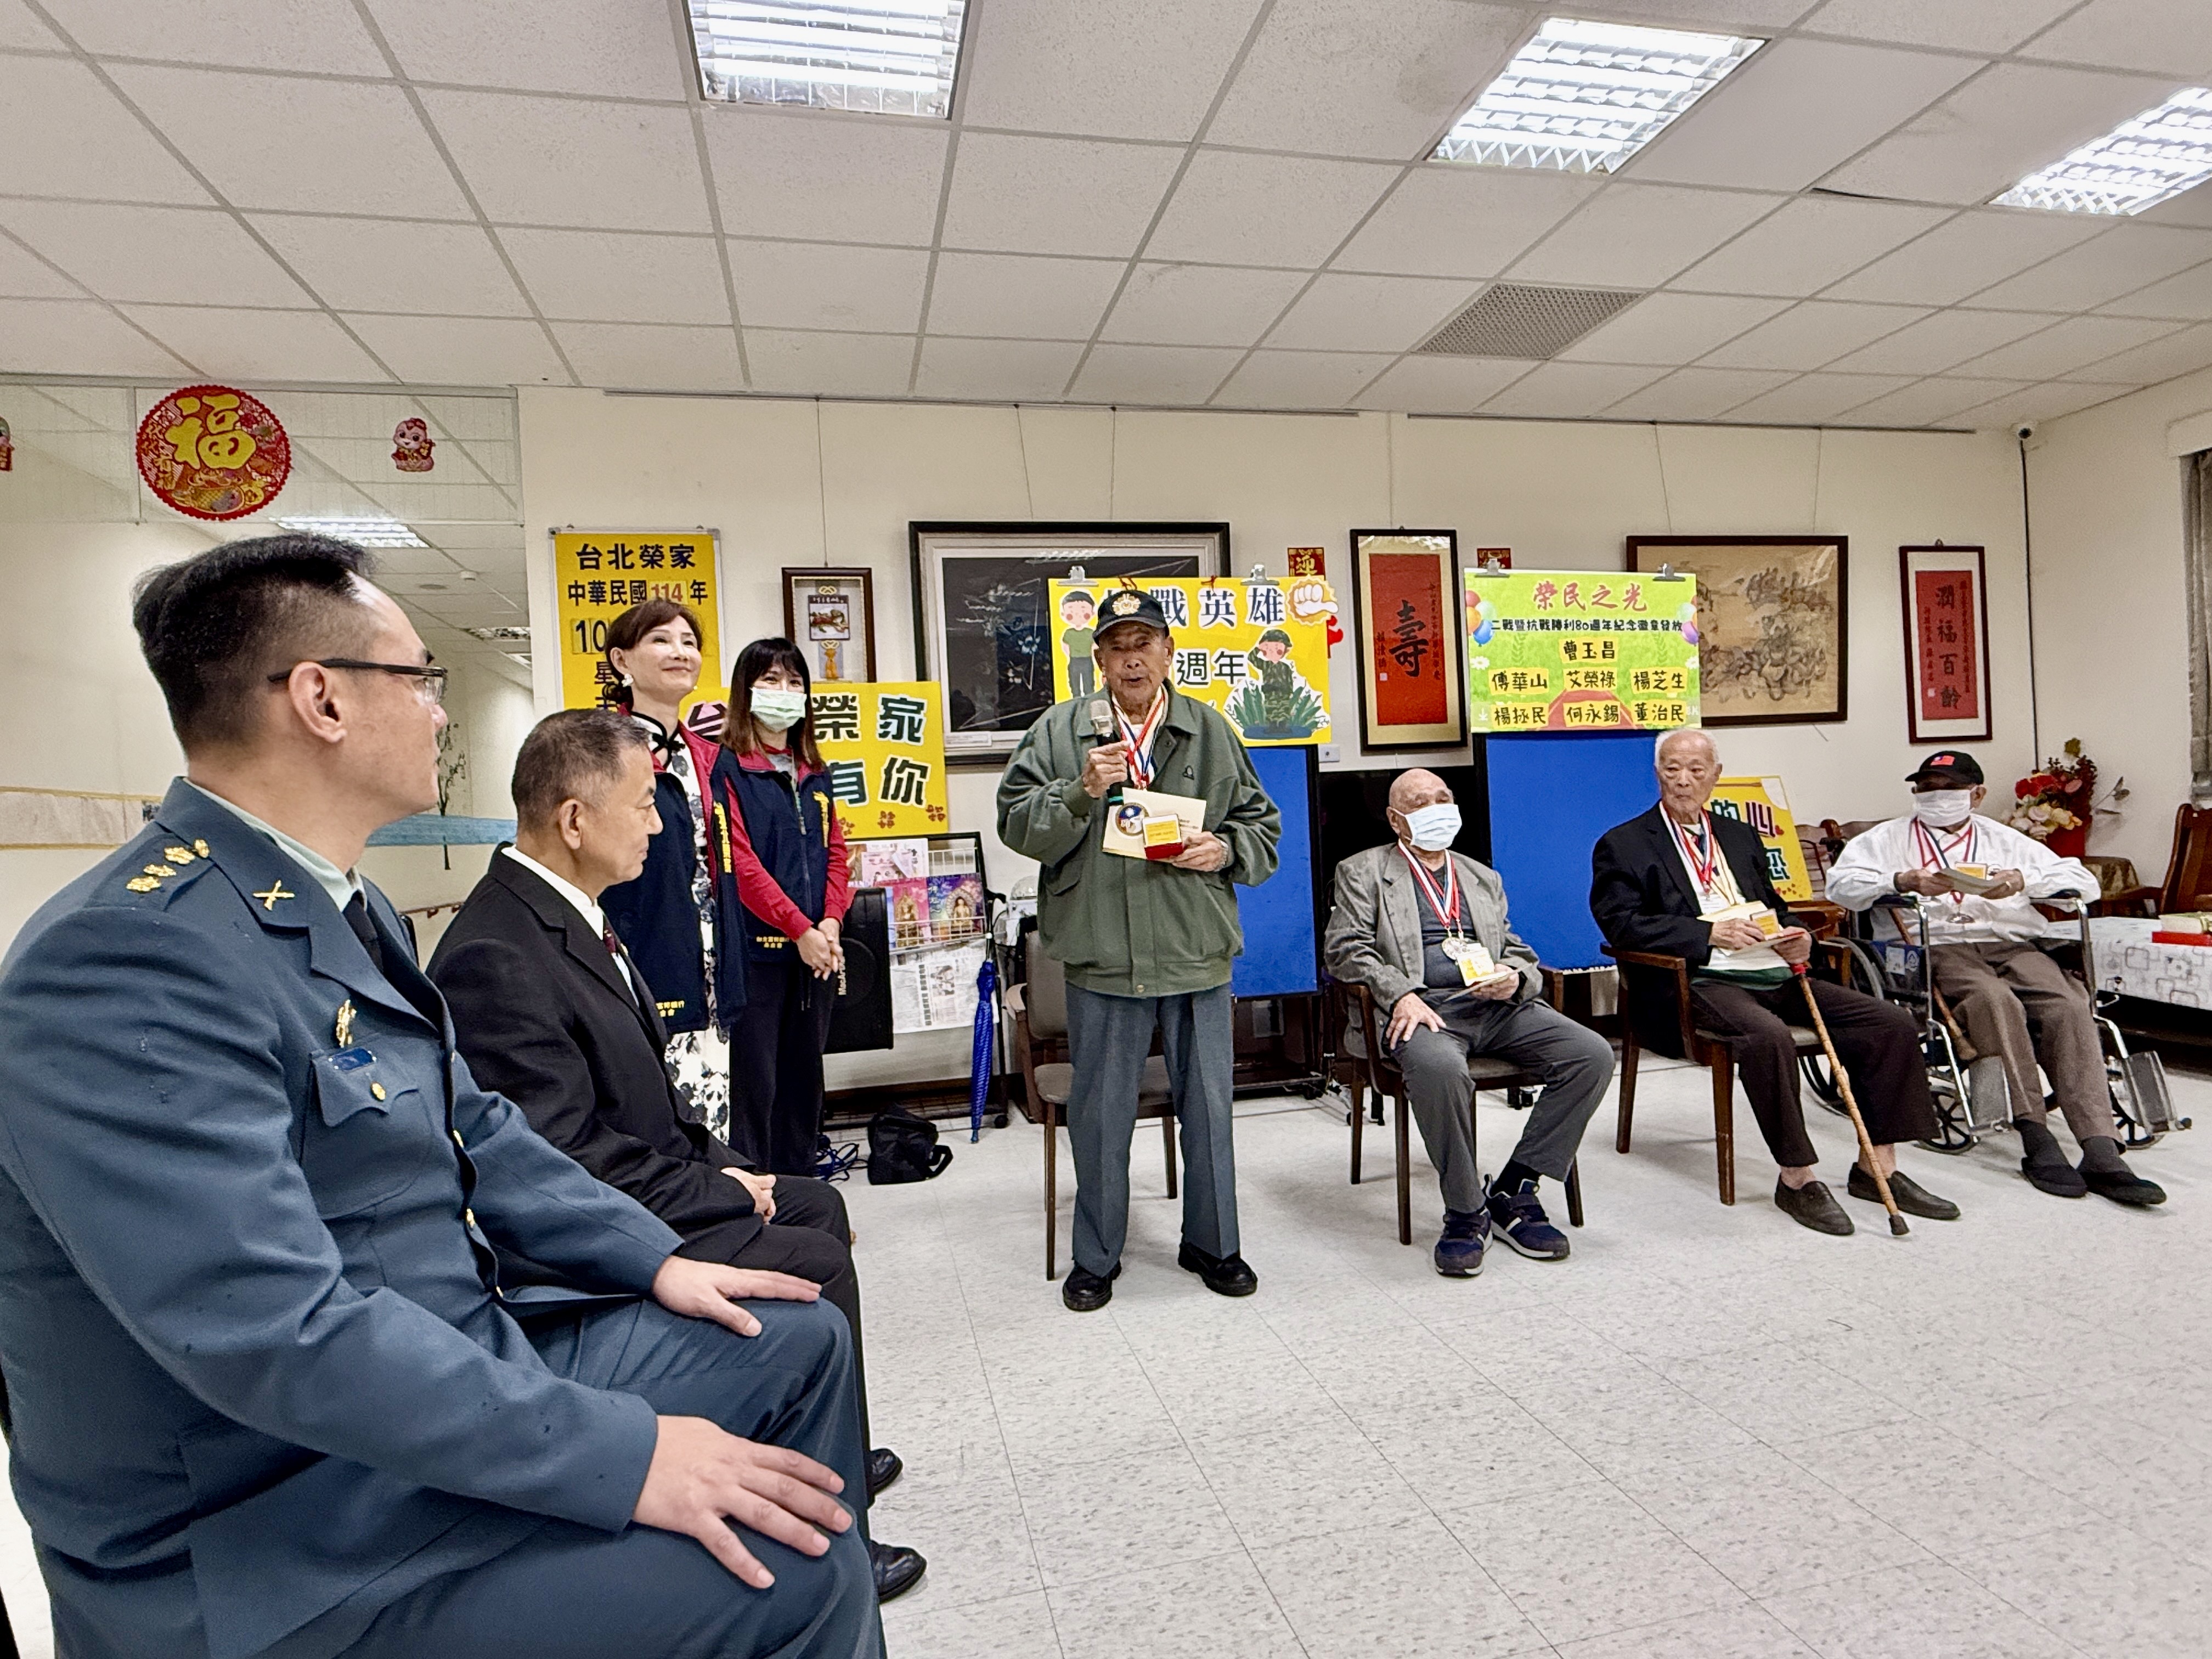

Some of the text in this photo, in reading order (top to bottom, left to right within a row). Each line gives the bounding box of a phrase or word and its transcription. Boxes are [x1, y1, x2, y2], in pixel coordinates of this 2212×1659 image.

[165, 393, 256, 469] 福
[575, 543, 696, 570] 台北榮家
[568, 579, 708, 606] 中華民國114年
[1533, 580, 1647, 612] 榮民之光
[1108, 588, 1285, 627] 戰英雄
[1388, 599, 1429, 678] 壽
[1564, 640, 1615, 661] 曹玉昌
[1177, 651, 1247, 686] 週年
[1492, 669, 1685, 691] 傅華山 艾榮祿 楊芝生
[1494, 702, 1684, 726] 楊拯民 何永錫 董治民
